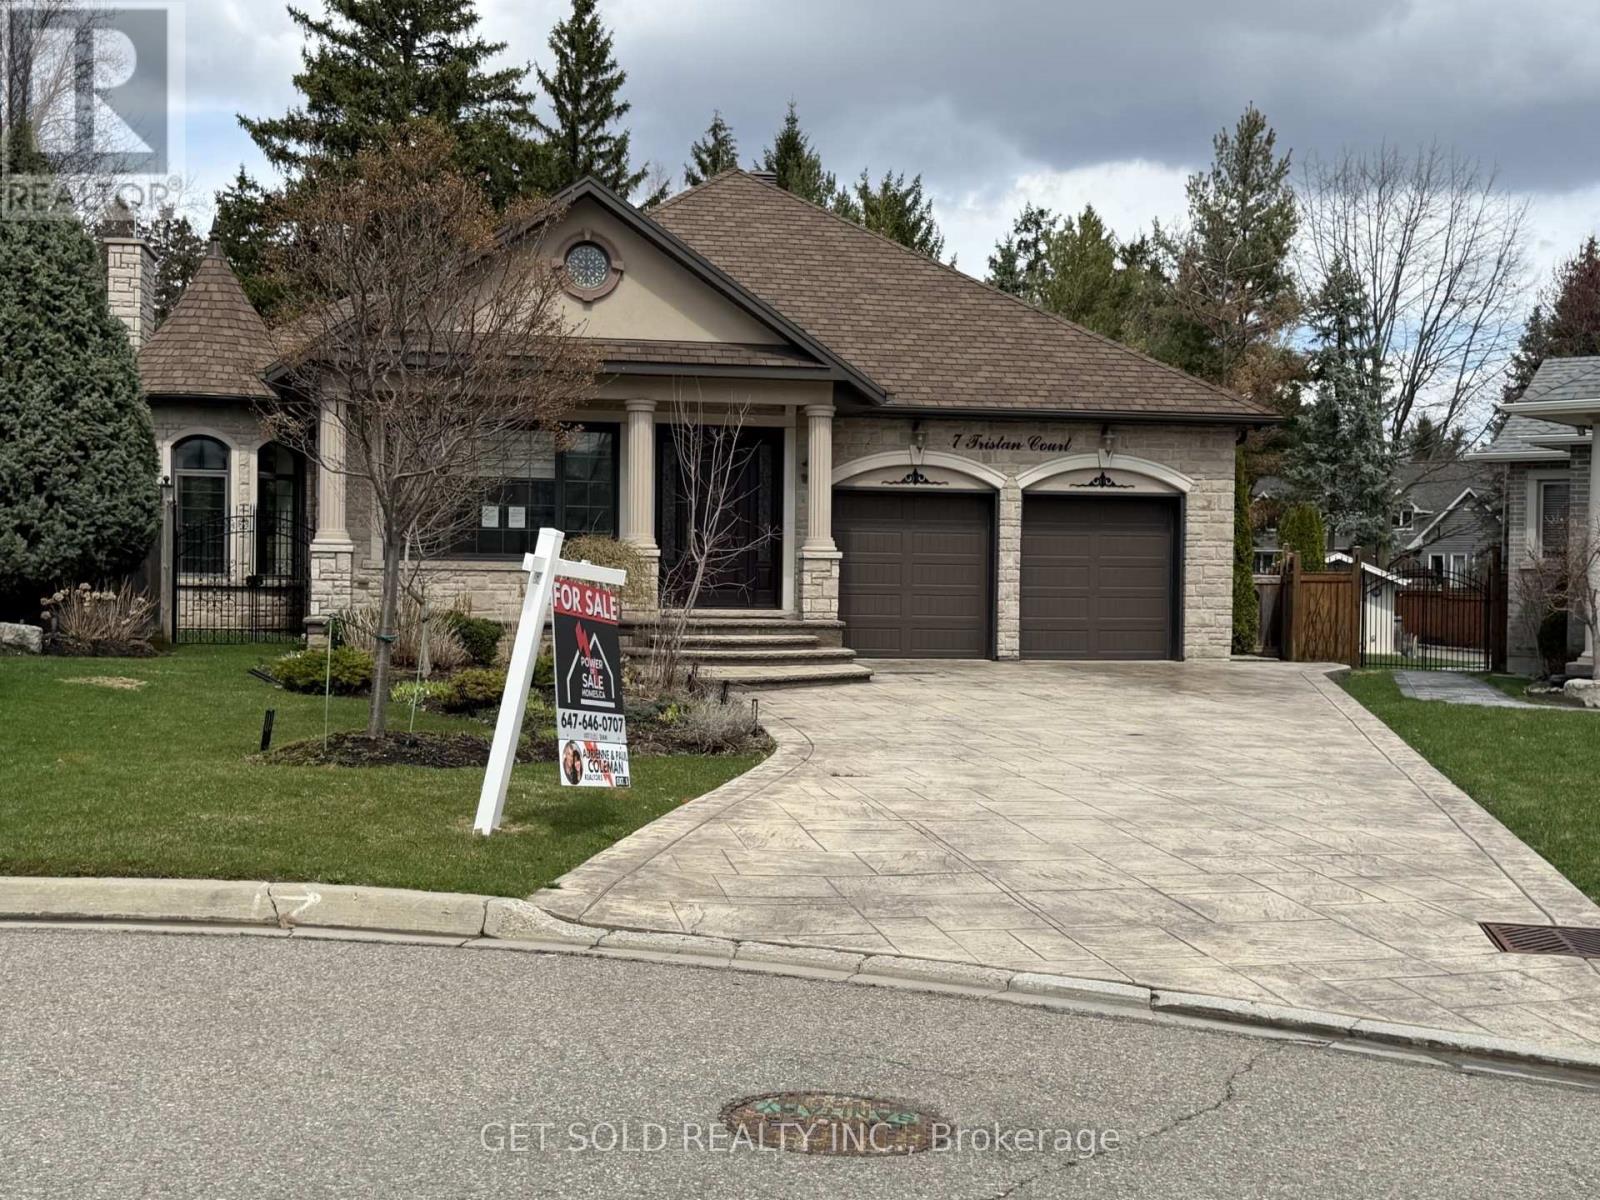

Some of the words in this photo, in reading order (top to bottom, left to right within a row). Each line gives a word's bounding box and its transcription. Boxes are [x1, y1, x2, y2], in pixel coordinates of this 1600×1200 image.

[952, 434, 962, 449] 7
[965, 434, 1023, 450] Tristan
[1027, 435, 1072, 451] Court
[553, 582, 581, 613] FOR
[586, 590, 617, 620] SALE
[581, 656, 603, 670] POWER
[582, 673, 604, 690] SALE
[561, 712, 624, 733] 647-646-0707
[588, 759, 624, 775] COLEMAN
